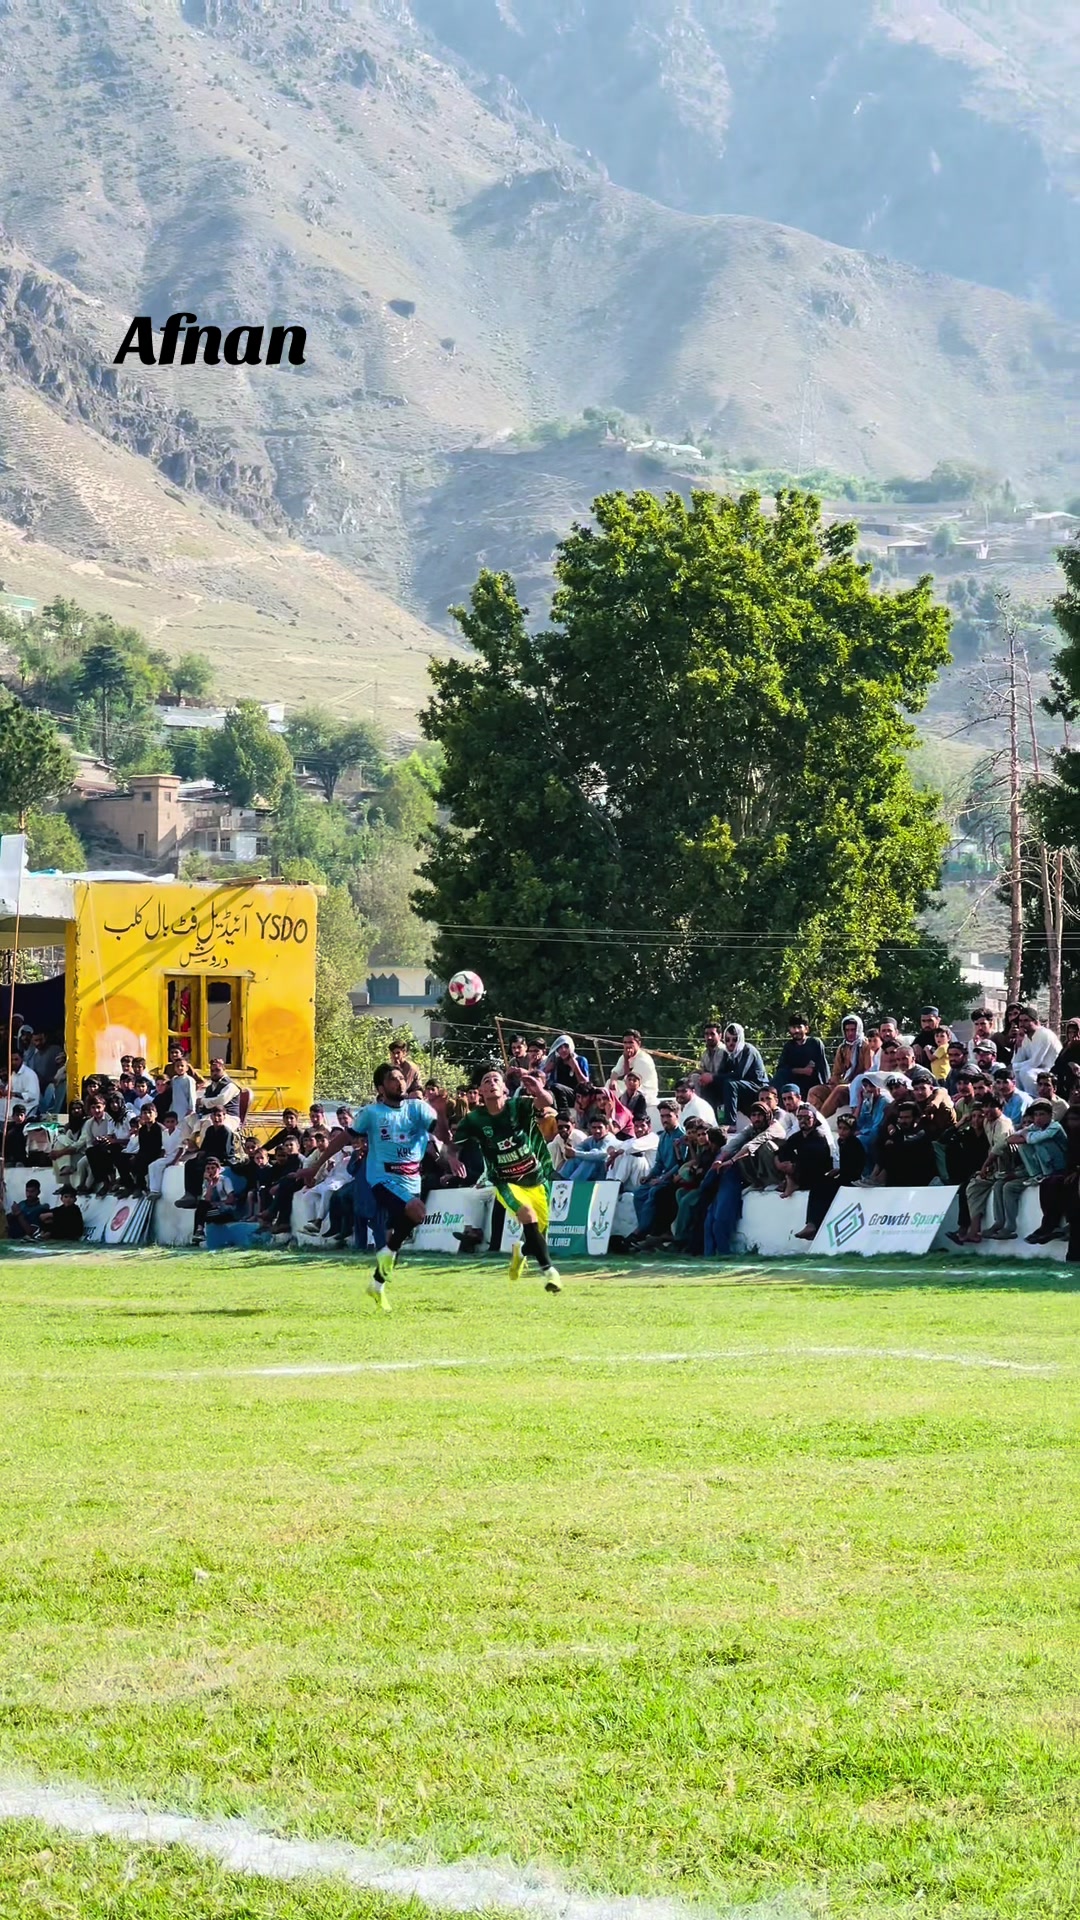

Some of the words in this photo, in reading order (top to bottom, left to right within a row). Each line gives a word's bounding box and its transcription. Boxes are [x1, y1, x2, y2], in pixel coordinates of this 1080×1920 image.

[103, 895, 154, 941] کلب
[144, 900, 169, 941] بال
[171, 906, 198, 936] فٹ
[256, 911, 308, 944] YSDO
[868, 1211, 911, 1227] Growth
